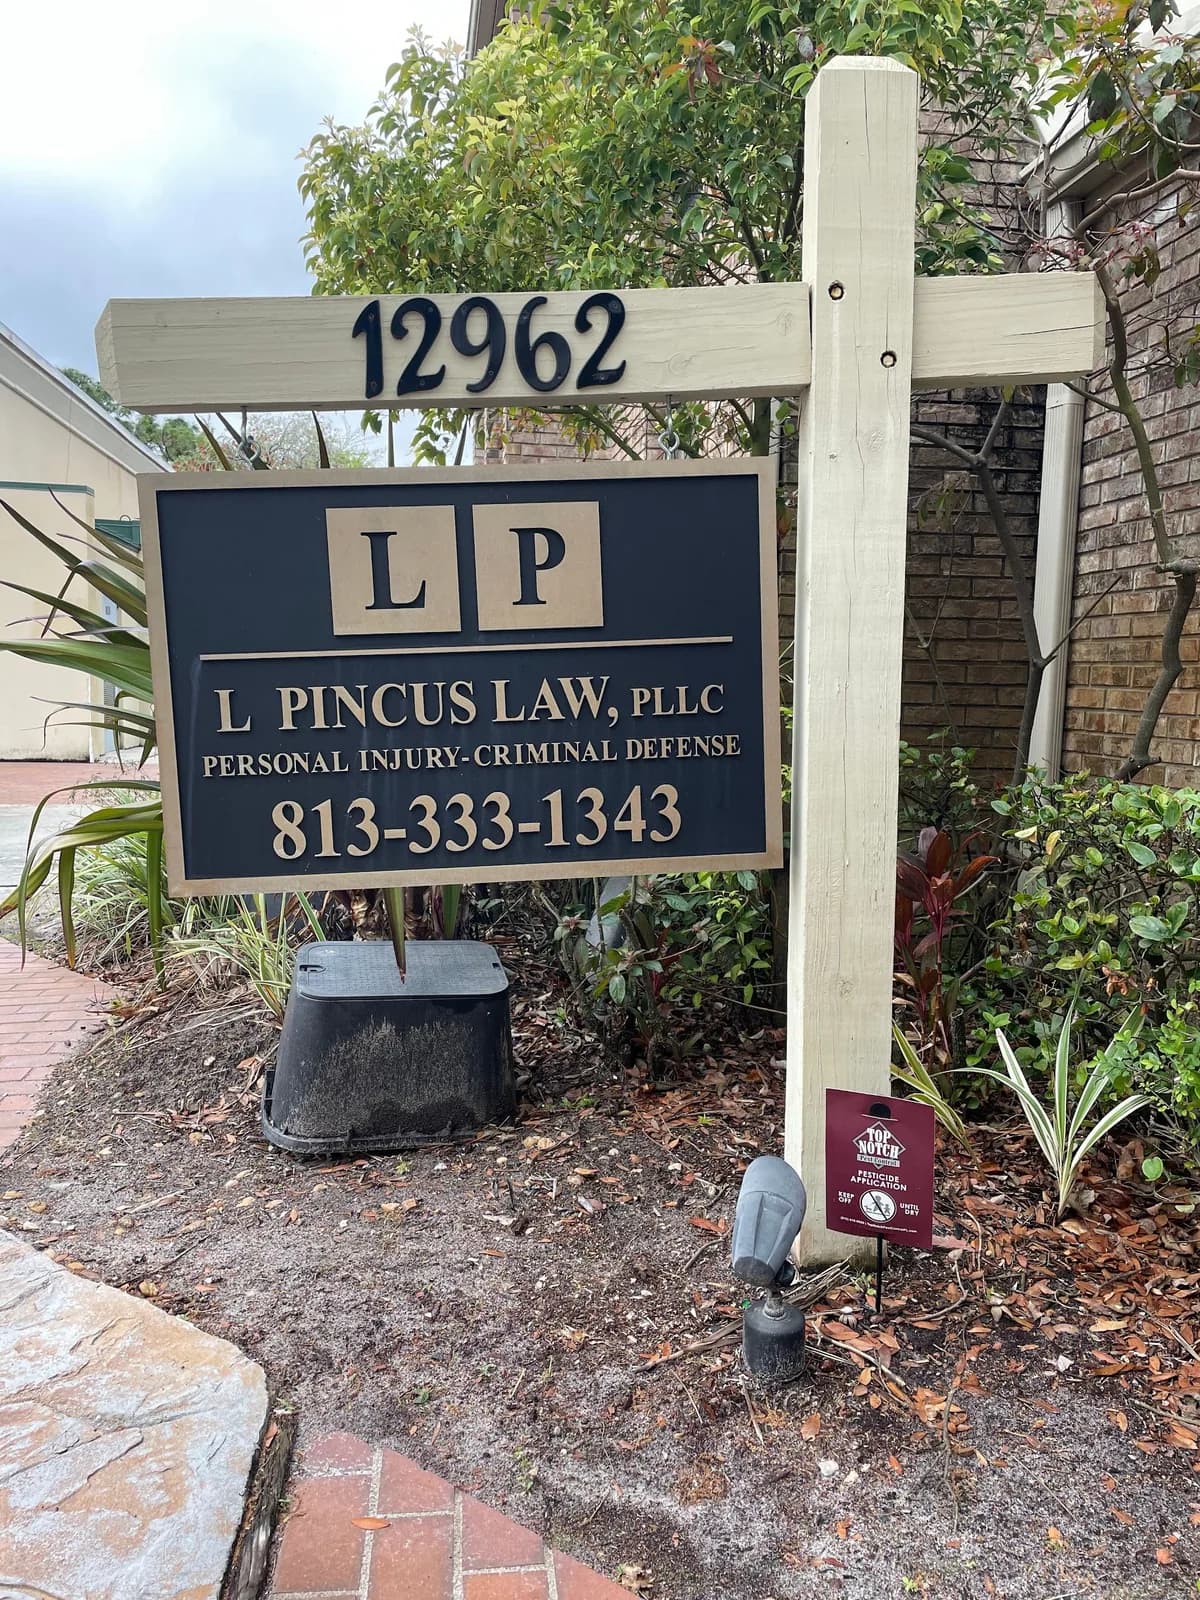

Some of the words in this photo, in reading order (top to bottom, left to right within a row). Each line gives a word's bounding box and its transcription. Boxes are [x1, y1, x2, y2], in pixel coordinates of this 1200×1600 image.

[351, 292, 627, 399] 12962
[360, 530, 426, 611] L
[509, 527, 567, 606] P
[214, 688, 252, 733] L
[276, 680, 477, 731] PINCUS
[491, 675, 619, 728] LAW,
[631, 684, 726, 718] PLLC
[202, 750, 349, 778] PERSONAL
[625, 734, 741, 760] DEFENSE
[271, 783, 683, 860] 813-333-1343
[866, 1127, 892, 1144] TOP
[858, 1140, 900, 1159] NOTCH
[850, 1175, 907, 1192] APPLICATION
[858, 1170, 900, 1183] PESTICIDE
[838, 1191, 855, 1199] KEEP
[838, 1196, 852, 1204] OFF
[899, 1202, 920, 1211] UNTIL
[904, 1209, 920, 1217] DRY
